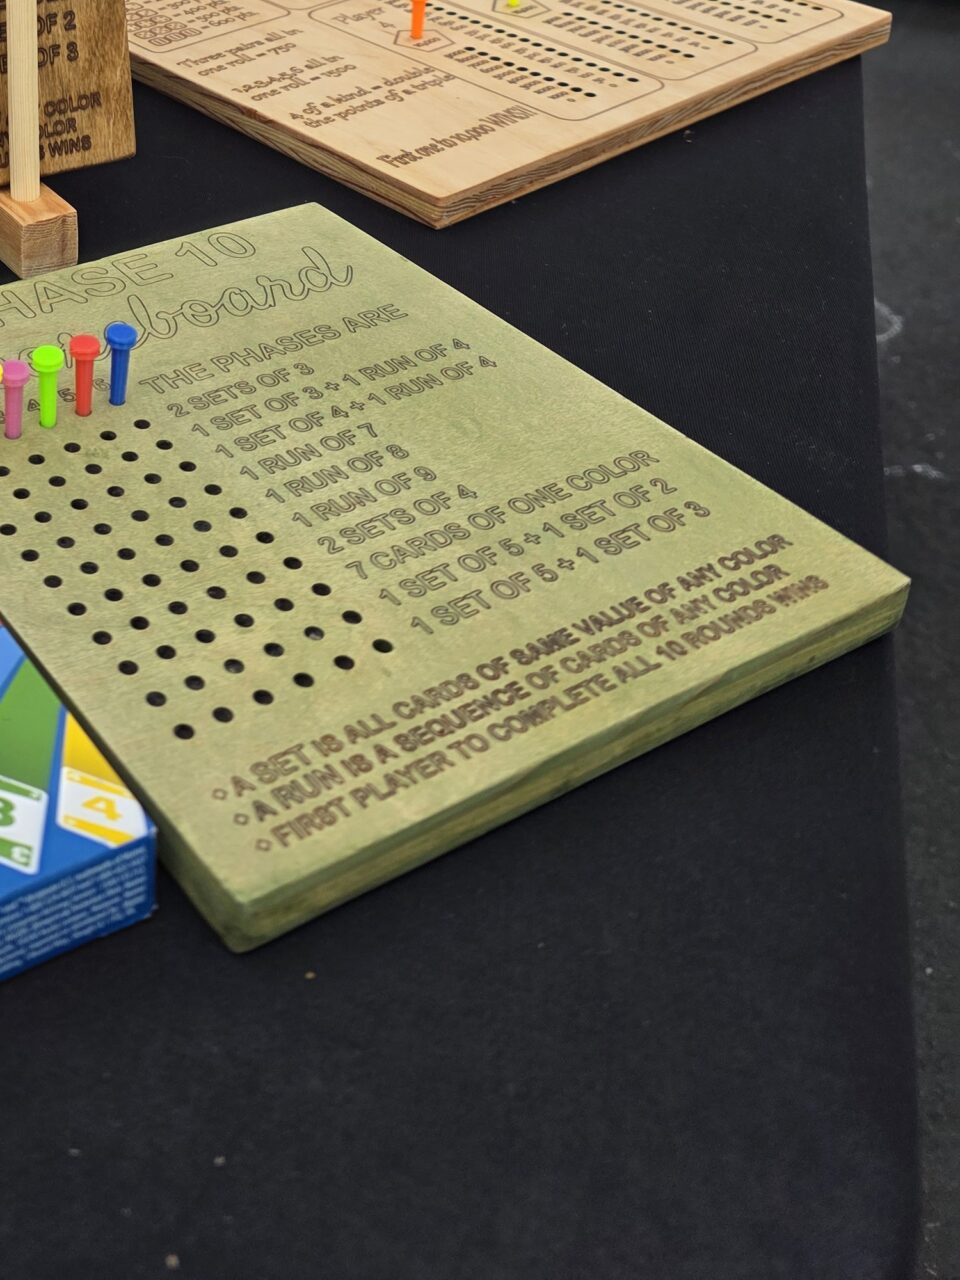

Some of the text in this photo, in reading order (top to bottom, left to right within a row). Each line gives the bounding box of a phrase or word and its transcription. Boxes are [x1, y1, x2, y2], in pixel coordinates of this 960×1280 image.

[332, 7, 385, 25] Player
[176, 28, 304, 68] Three pairs all in
[198, 62, 228, 76] one
[226, 54, 256, 68] roll
[268, 42, 296, 56] 750
[304, 58, 326, 70] all
[322, 53, 344, 63] in
[251, 88, 281, 102] one
[279, 77, 310, 91] roll
[321, 64, 357, 78] 1500
[303, 102, 322, 115] of
[327, 86, 372, 104] kind
[382, 66, 436, 86] double
[303, 116, 335, 128] the
[334, 98, 385, 121] points
[385, 89, 405, 102] of
[410, 74, 457, 90] triple
[376, 149, 423, 168] First
[415, 142, 445, 156] one
[431, 137, 458, 148] to
[175, 231, 257, 269] 10
[138, 303, 408, 395] THE PHASES ARE
[345, 449, 660, 580] 7 CARDS OF ONE COLOR
[231, 533, 794, 797] A SET IS ALL CARDS OF SAME VALUE OF ANY COLOR
[252, 563, 791, 822] A RUN IS A SEQUENCE OF CARDS OF ANY COLOR
[270, 574, 830, 848] FIRST PLAYER TO COMPLETE ALL 10 ROUNDS WINS
[81, 796, 123, 821] 4
